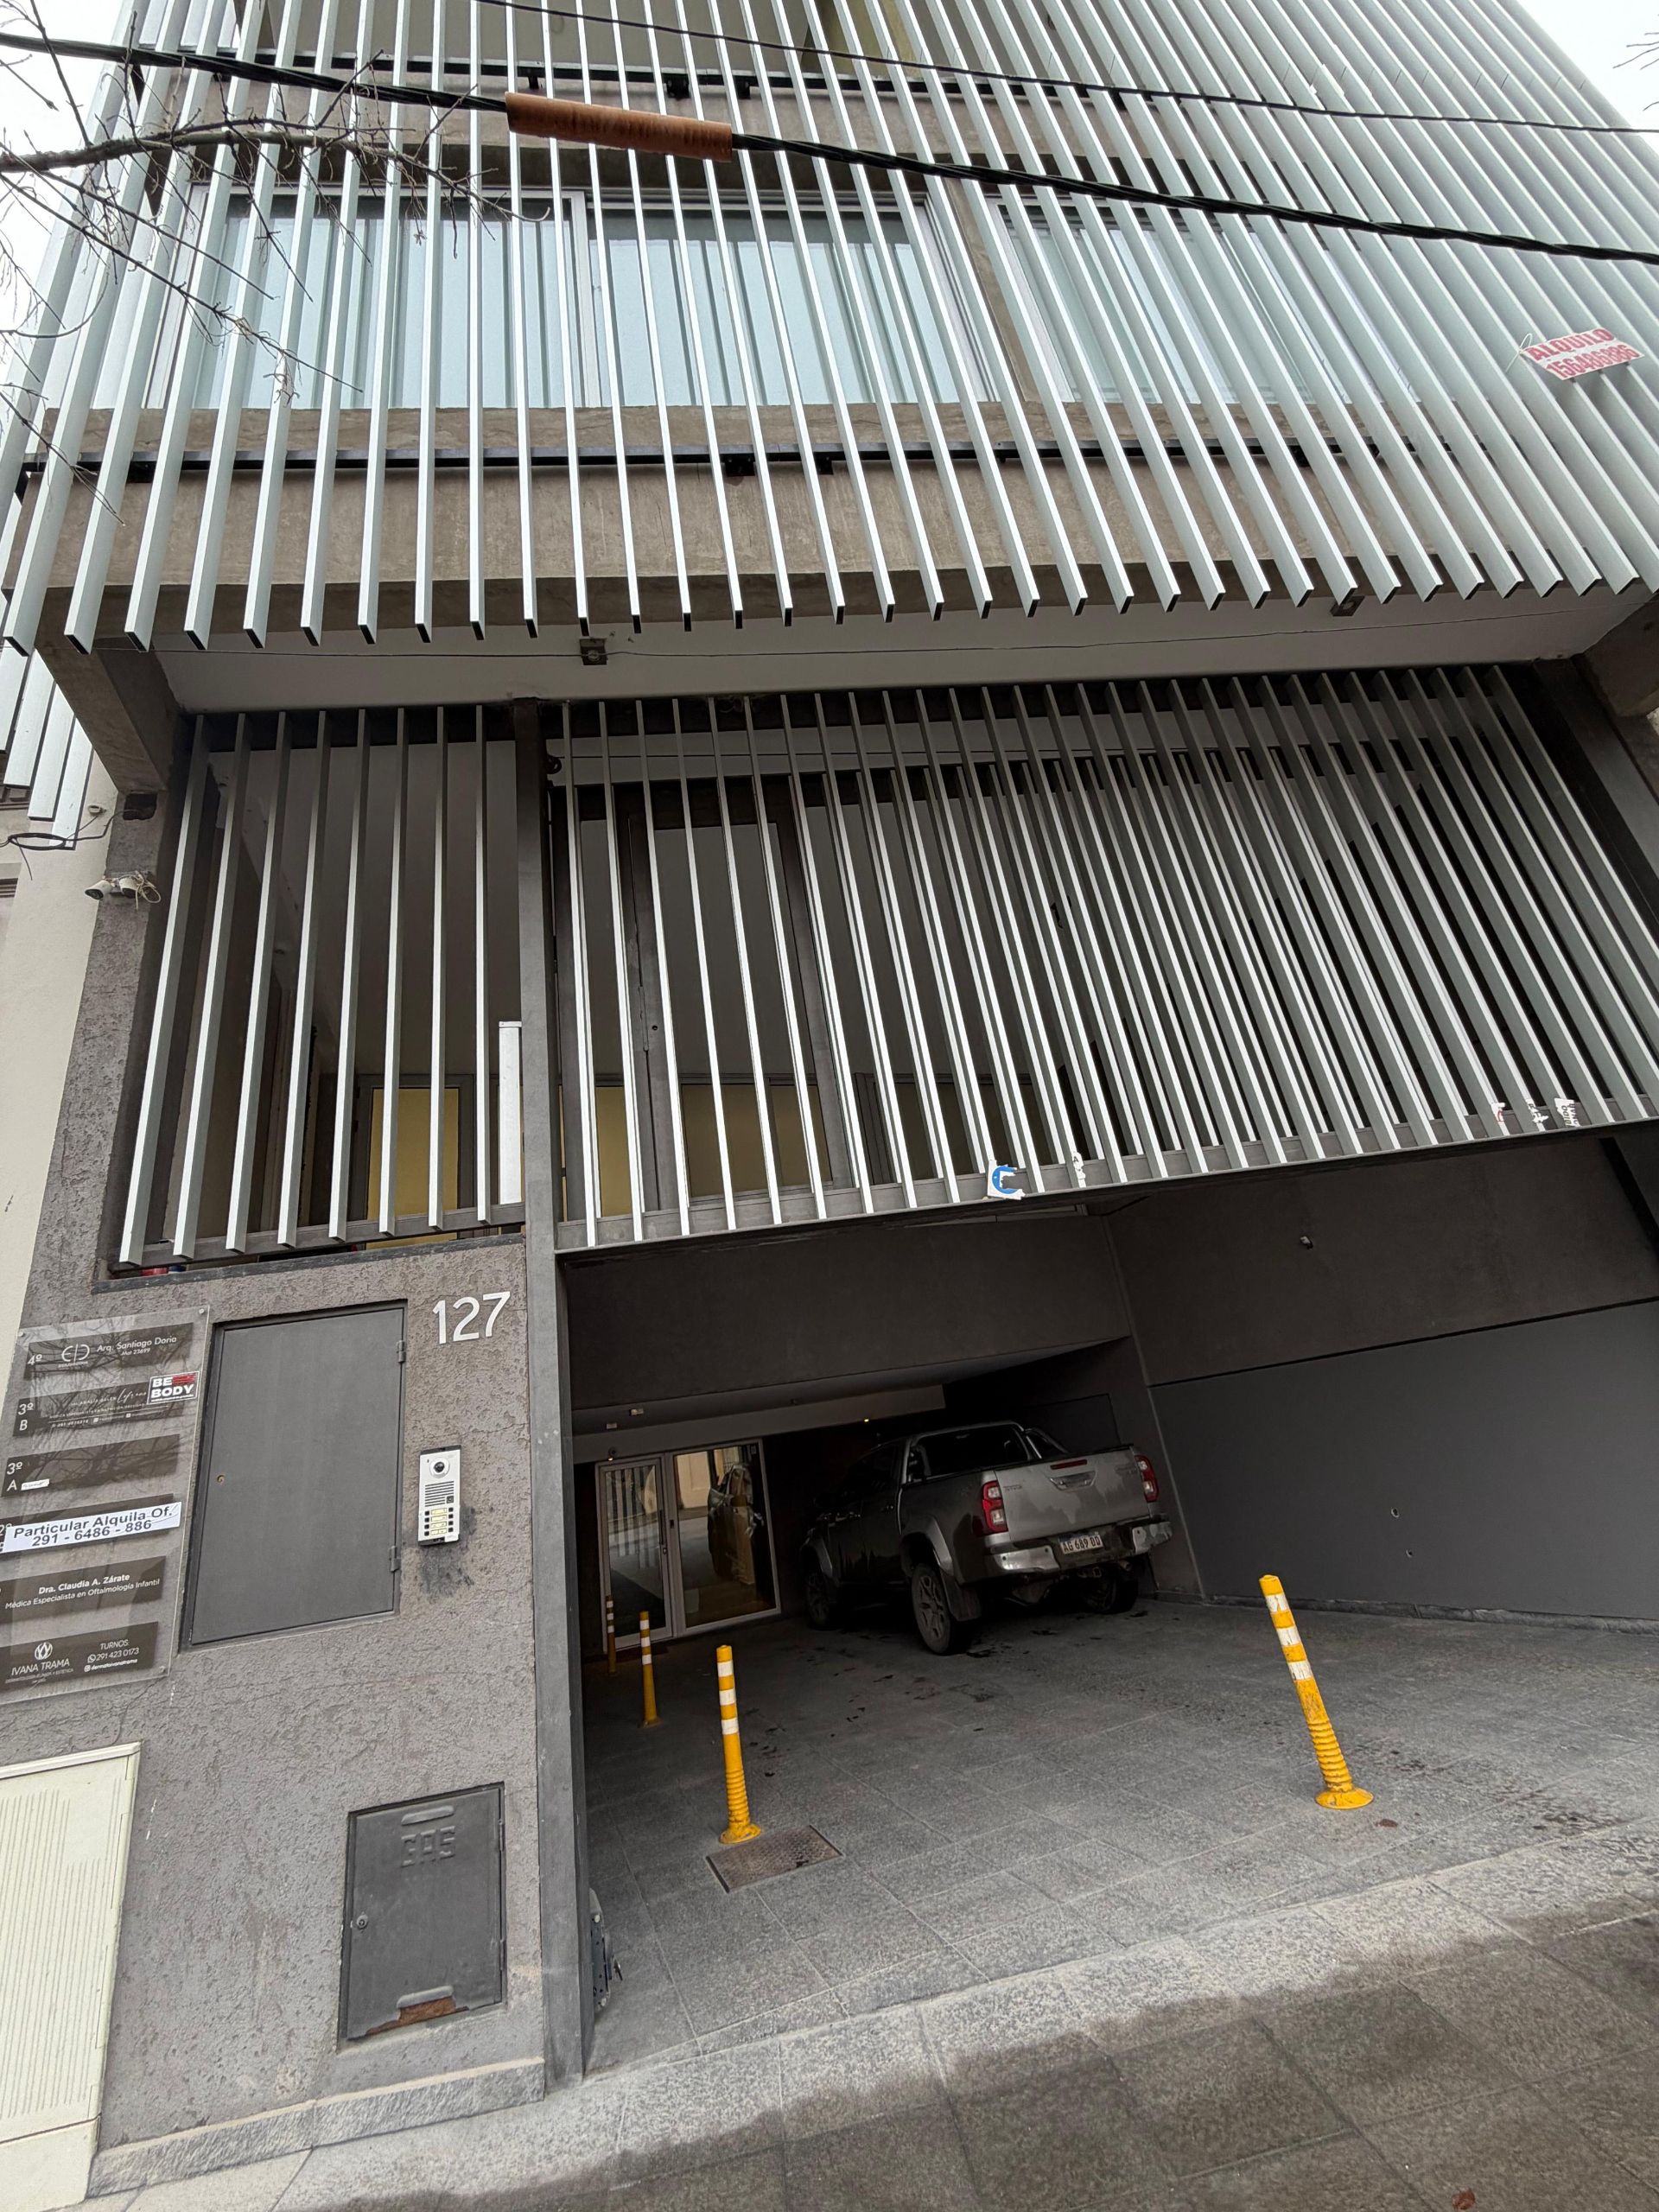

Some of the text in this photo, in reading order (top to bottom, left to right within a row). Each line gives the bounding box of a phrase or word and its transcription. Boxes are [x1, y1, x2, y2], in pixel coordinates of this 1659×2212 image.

[1527, 328, 1615, 361] ALQUILO
[432, 1292, 511, 1344] 127
[97, 1336, 177, 1354] Arq. Santiago Doria
[150, 1384, 194, 1398] BODY
[152, 1377, 173, 1388] BE
[19, 1419, 28, 1431] B
[6, 1479, 17, 1491] A
[14, 1506, 172, 1538] Particular Alquila Of.
[32, 1534, 58, 1547] 291
[74, 1526, 111, 1541] 6486
[125, 1520, 152, 1532] 886
[58, 1580, 90, 1591] Claudia
[103, 1574, 130, 1584] Zárate
[5, 1600, 31, 1610] Médica
[33, 1592, 75, 1605] Especialista
[87, 1583, 134, 1596] Oftalmología
[136, 1578, 160, 1588] Infantil
[109, 1649, 122, 1658] 423
[123, 1647, 139, 1656] 0173
[11, 1658, 70, 1676] IVANA TRAMA
[400, 1826, 455, 1868] GAS
